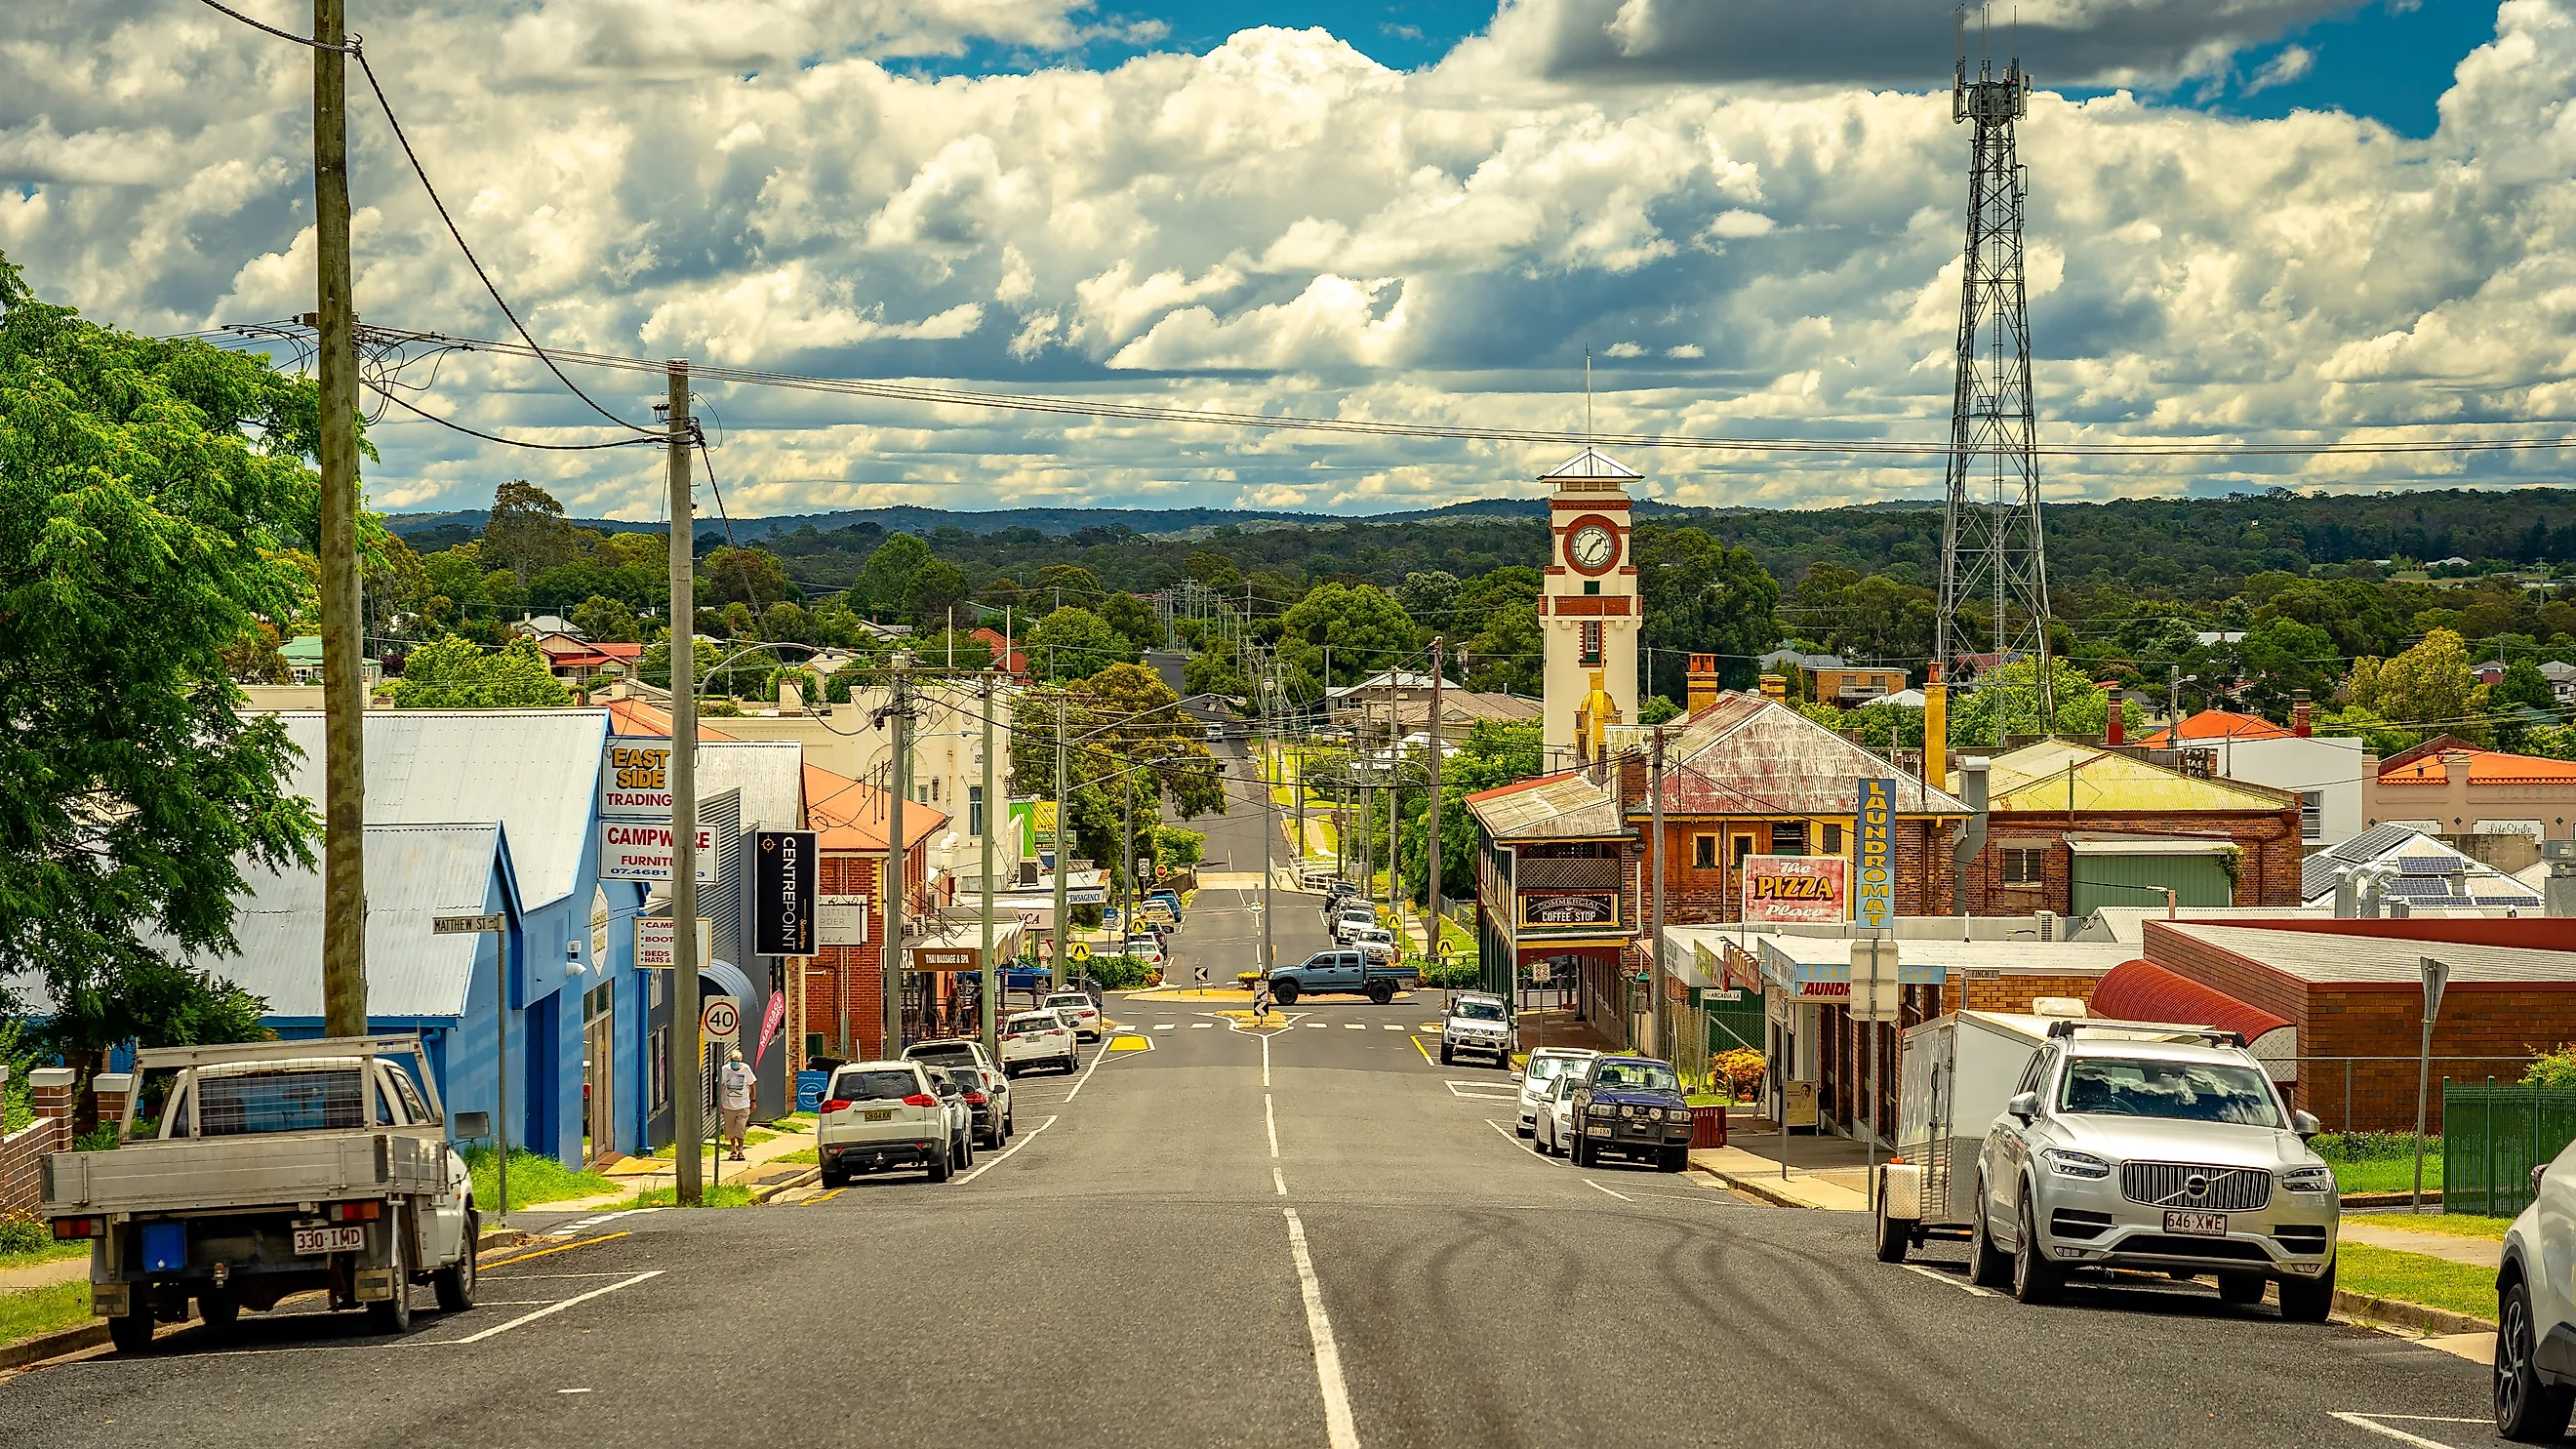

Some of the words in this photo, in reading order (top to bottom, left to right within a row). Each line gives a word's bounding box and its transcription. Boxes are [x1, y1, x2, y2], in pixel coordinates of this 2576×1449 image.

[612, 748, 670, 769] EAST
[616, 769, 666, 789] SIDE
[606, 793, 672, 806] TRADING
[1861, 782, 1889, 927] LAUNDROMAT
[1779, 862, 1812, 874] The
[783, 836, 797, 950] CENTREPOINT
[1753, 875, 1834, 901] PIZZA
[1538, 898, 1600, 909] COMMERCIAL
[1764, 904, 1824, 917] Place
[1542, 911, 1571, 922] COFFEE
[1575, 911, 1596, 922] STOP
[434, 918, 472, 931] MATTHEW
[476, 918, 486, 930] ST
[937, 953, 956, 964] MASSAGE
[960, 954, 970, 964] SPA
[709, 1011, 734, 1027] 40
[760, 995, 783, 1048] MASSAGE
